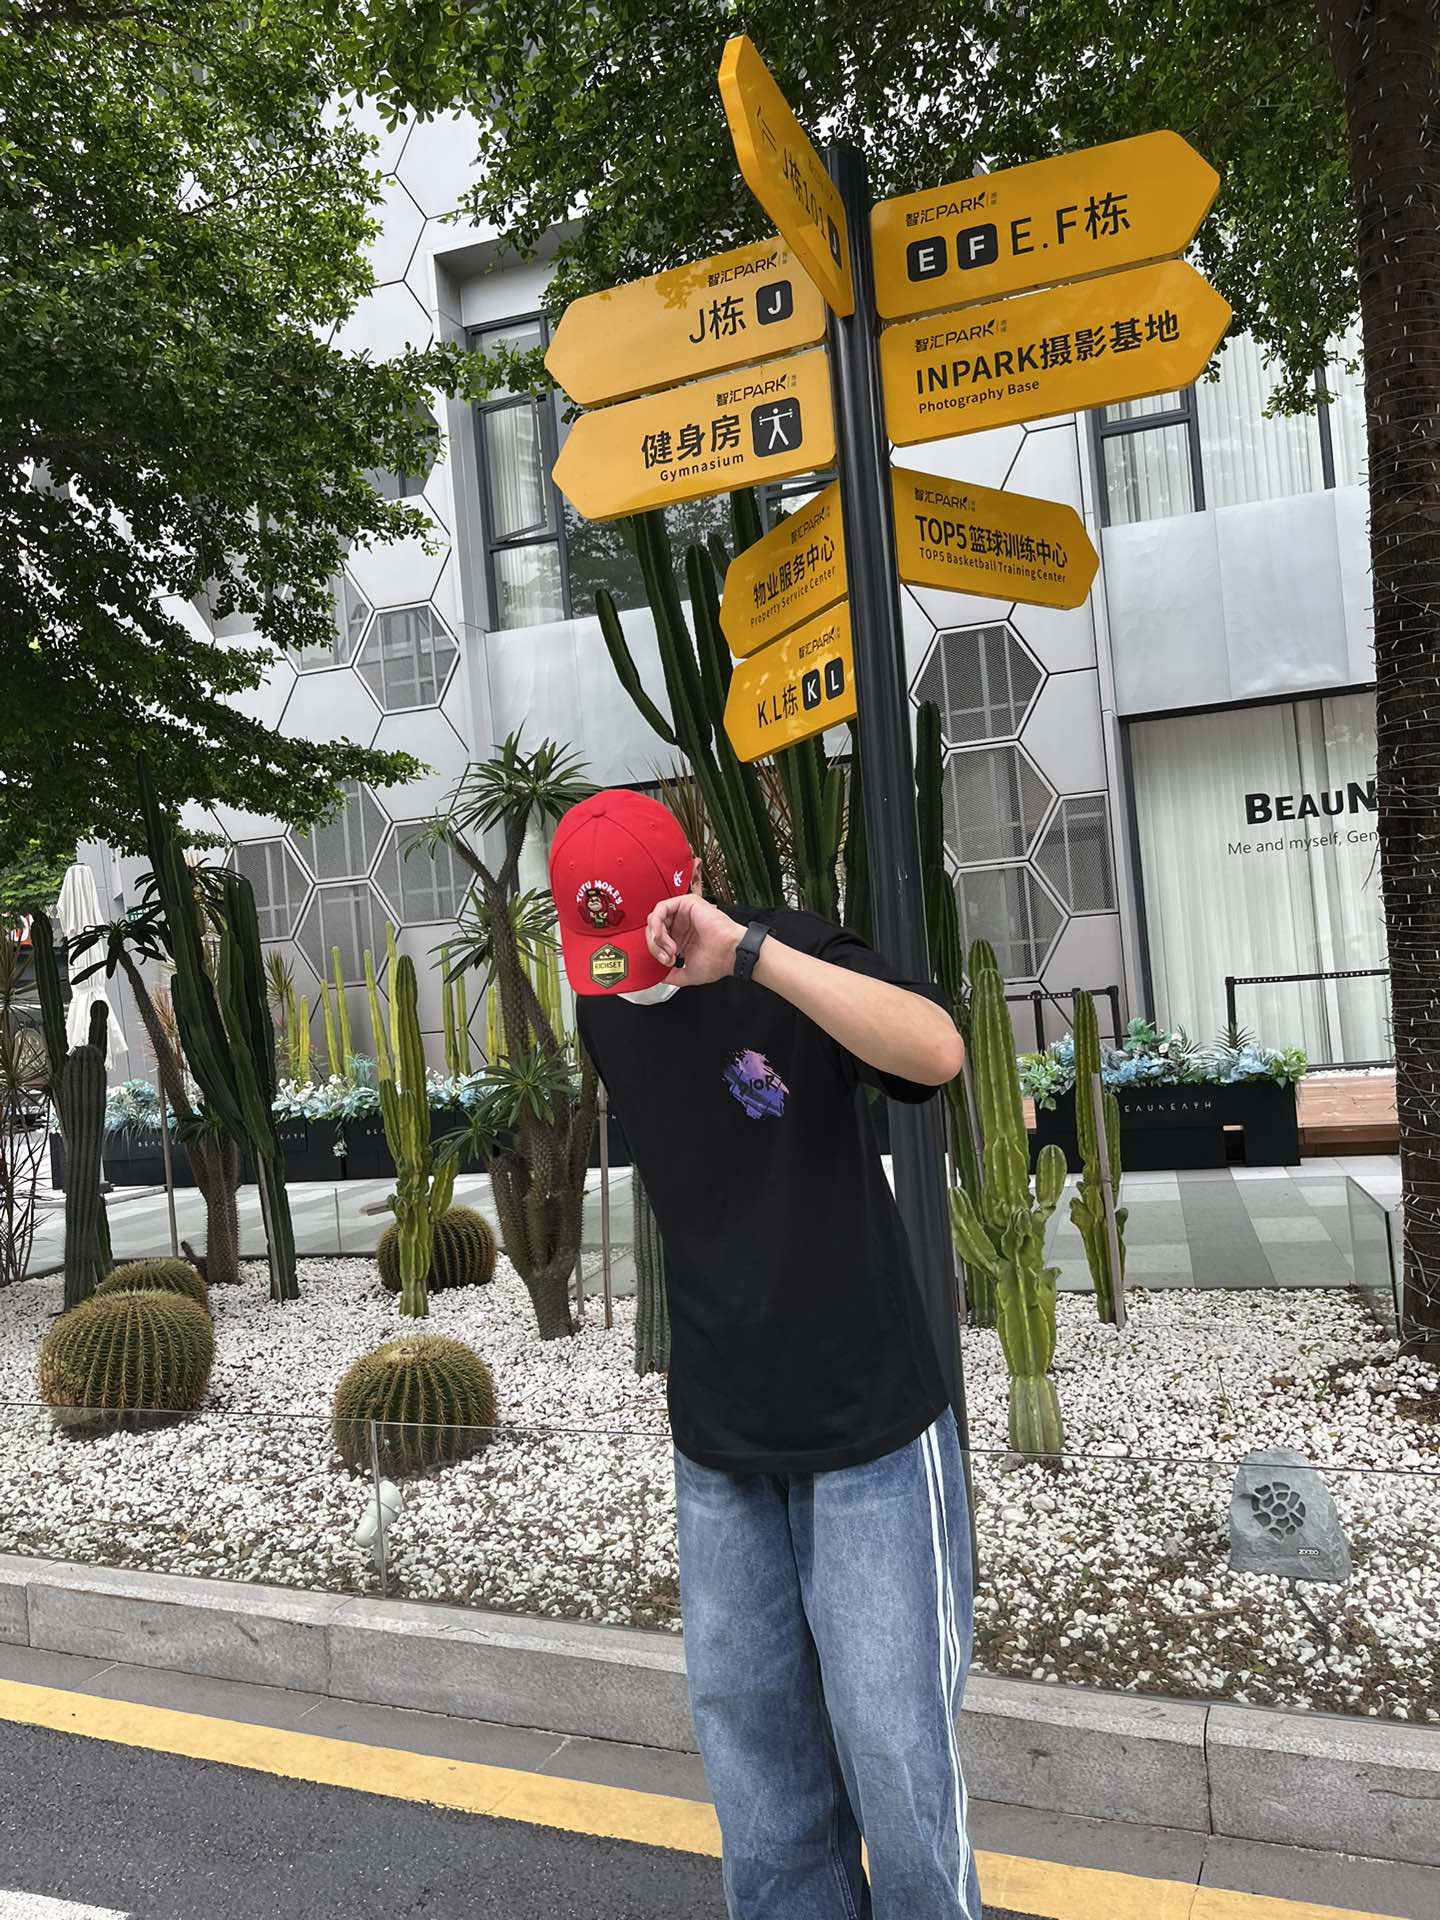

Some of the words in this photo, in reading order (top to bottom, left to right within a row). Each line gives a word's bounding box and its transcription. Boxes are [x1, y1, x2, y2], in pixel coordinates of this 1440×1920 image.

[918, 247, 936, 273] E
[969, 235, 985, 261] F
[1010, 191, 1131, 256] E.F栋
[688, 296, 747, 344] J栋
[766, 291, 782, 315] J
[919, 386, 1005, 414] Photography
[1008, 379, 1040, 396] Base
[641, 414, 742, 469] 健身房
[660, 453, 744, 482] Gymnasium
[753, 535, 835, 609] 物业服务中心
[919, 547, 945, 562] TOP5
[946, 552, 997, 571] Basketball
[998, 562, 1036, 581] Training
[1037, 569, 1067, 583] Center
[750, 603, 780, 628] Property
[781, 586, 808, 608] Service
[809, 566, 836, 590] Center
[757, 684, 799, 728] K.L栋
[807, 678, 818, 702] K
[831, 670, 840, 691] L
[1228, 842, 1252, 856] Me
[1256, 838, 1283, 853] and
[1289, 832, 1342, 851] myself,
